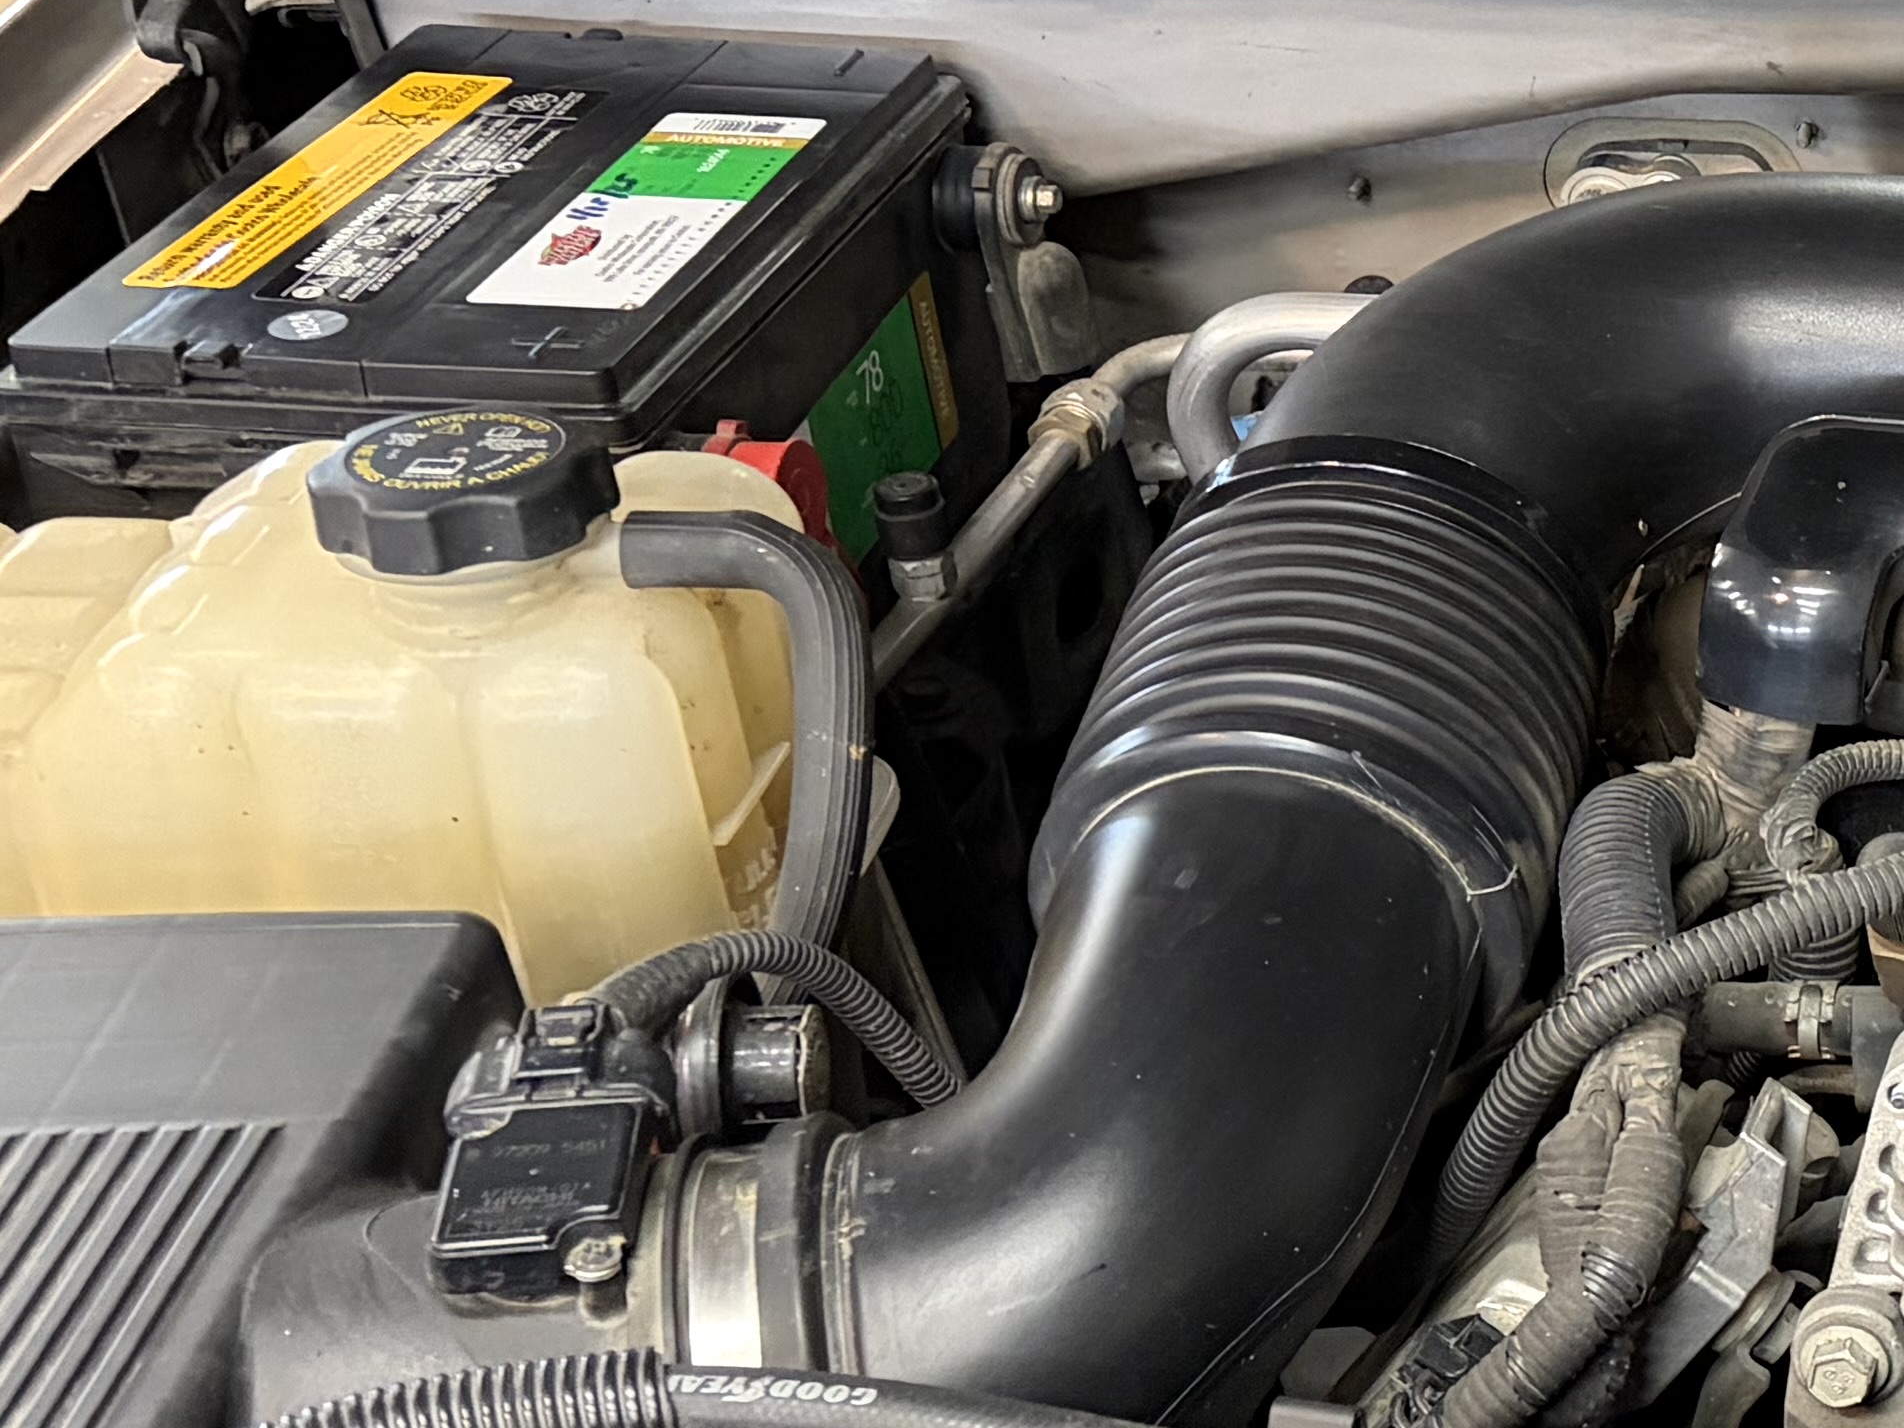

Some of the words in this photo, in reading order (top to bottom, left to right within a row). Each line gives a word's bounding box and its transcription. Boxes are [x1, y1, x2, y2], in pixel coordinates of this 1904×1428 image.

[665, 133, 785, 148] AUTOMOTIVE
[856, 350, 884, 404] 78
[416, 412, 477, 428] NEVER
[383, 477, 463, 490] OUVRIR
